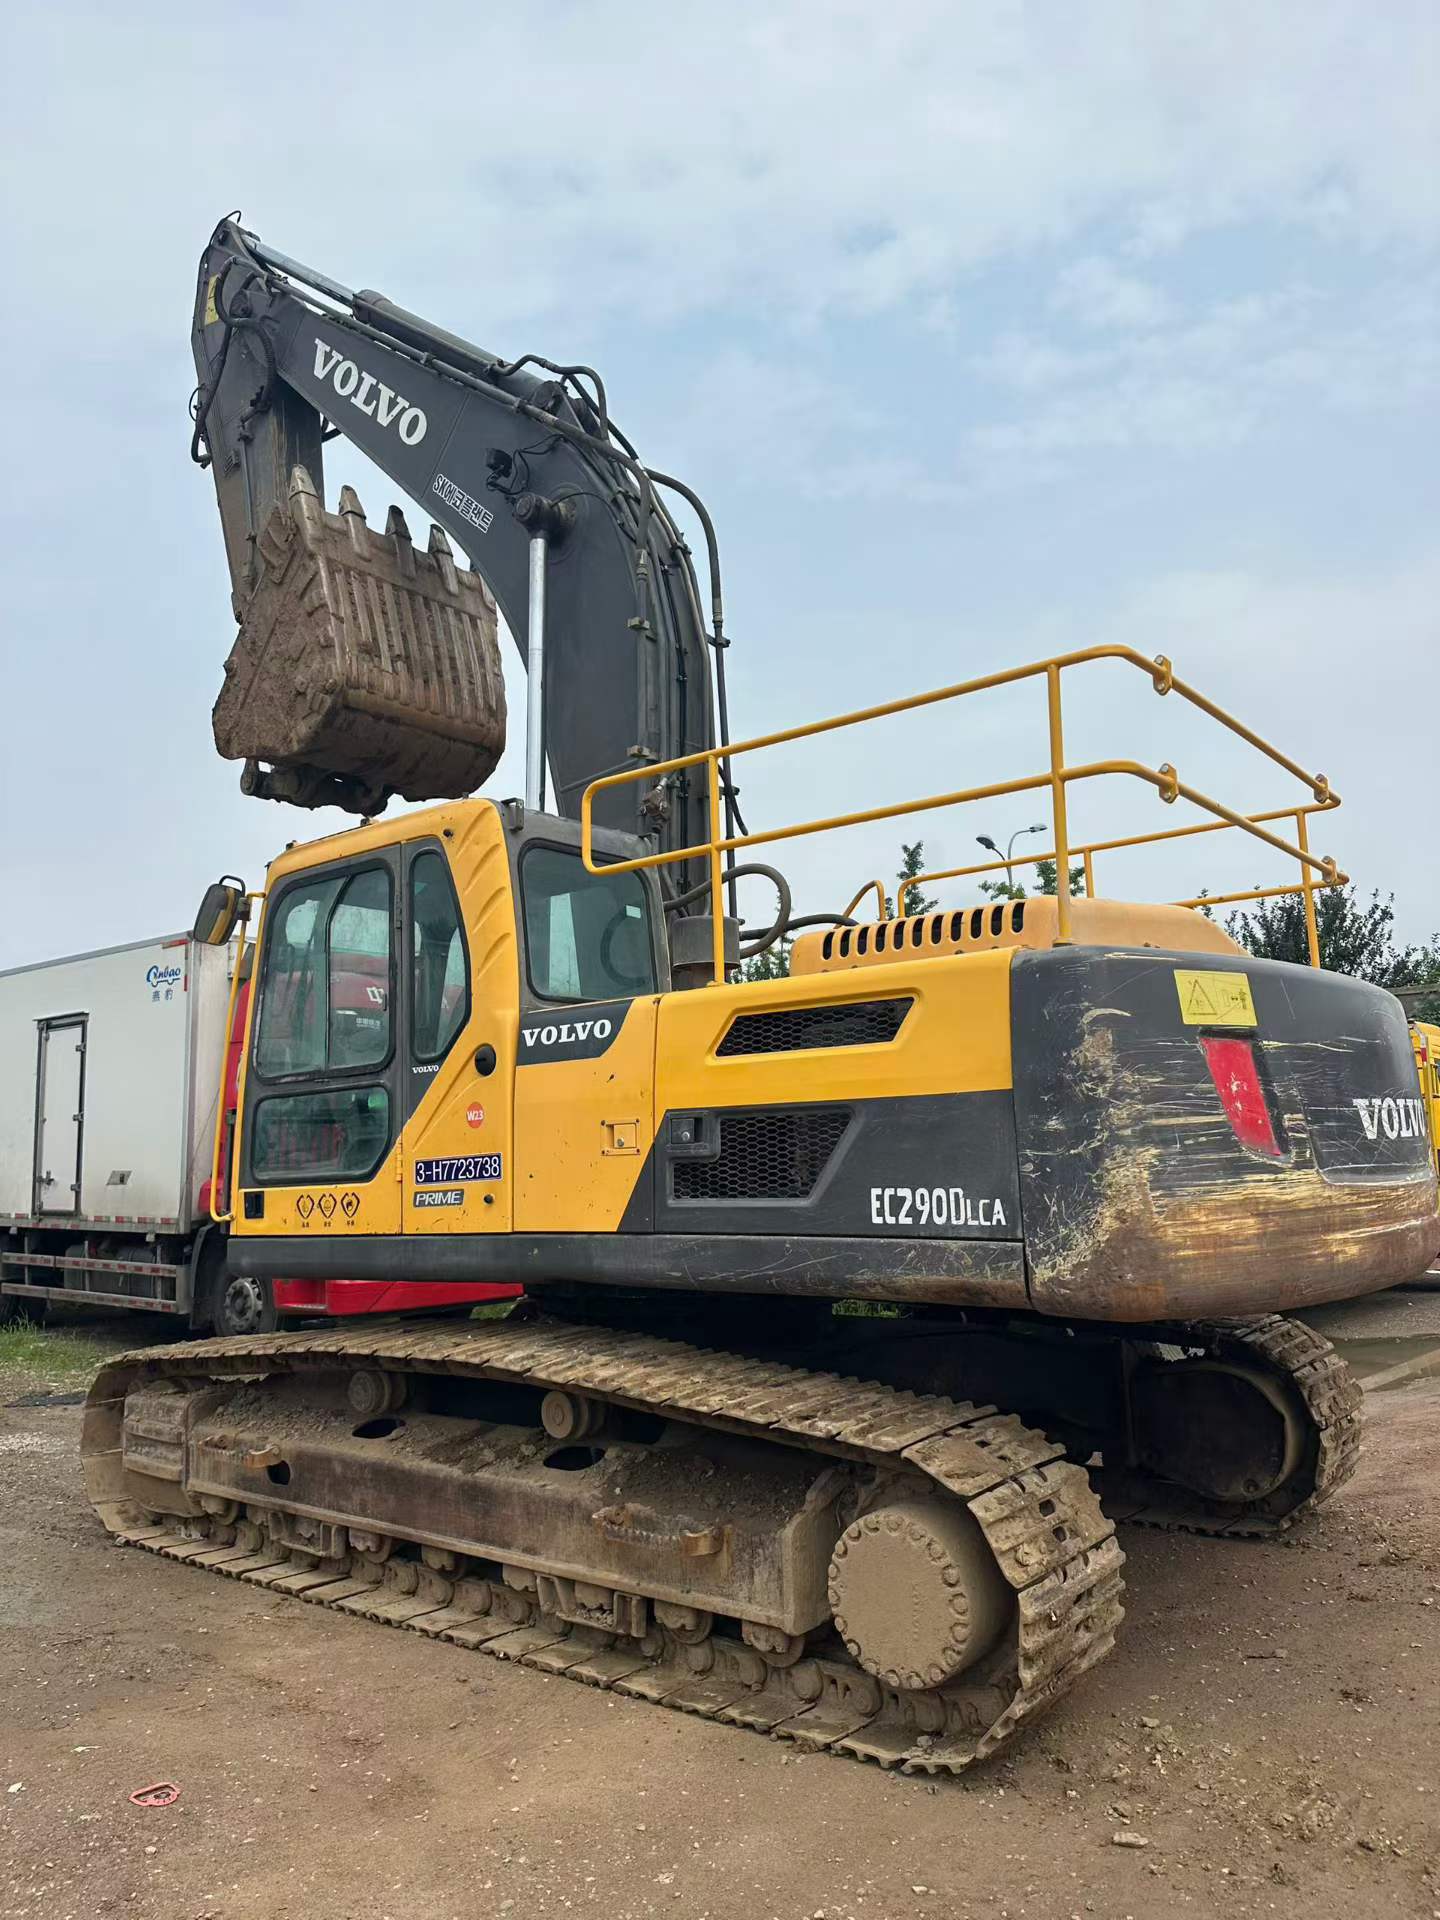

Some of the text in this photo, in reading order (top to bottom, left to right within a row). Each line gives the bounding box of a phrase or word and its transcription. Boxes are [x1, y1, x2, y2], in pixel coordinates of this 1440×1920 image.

[313, 337, 428, 446] VOLVO
[432, 473, 494, 534] SK에코플랜트
[522, 1019, 612, 1047] VOLVO
[412, 1064, 440, 1074] VOLVO
[466, 1110, 484, 1121] W23
[416, 1156, 500, 1182] 3-H7723738
[415, 1191, 461, 1206] PRIME
